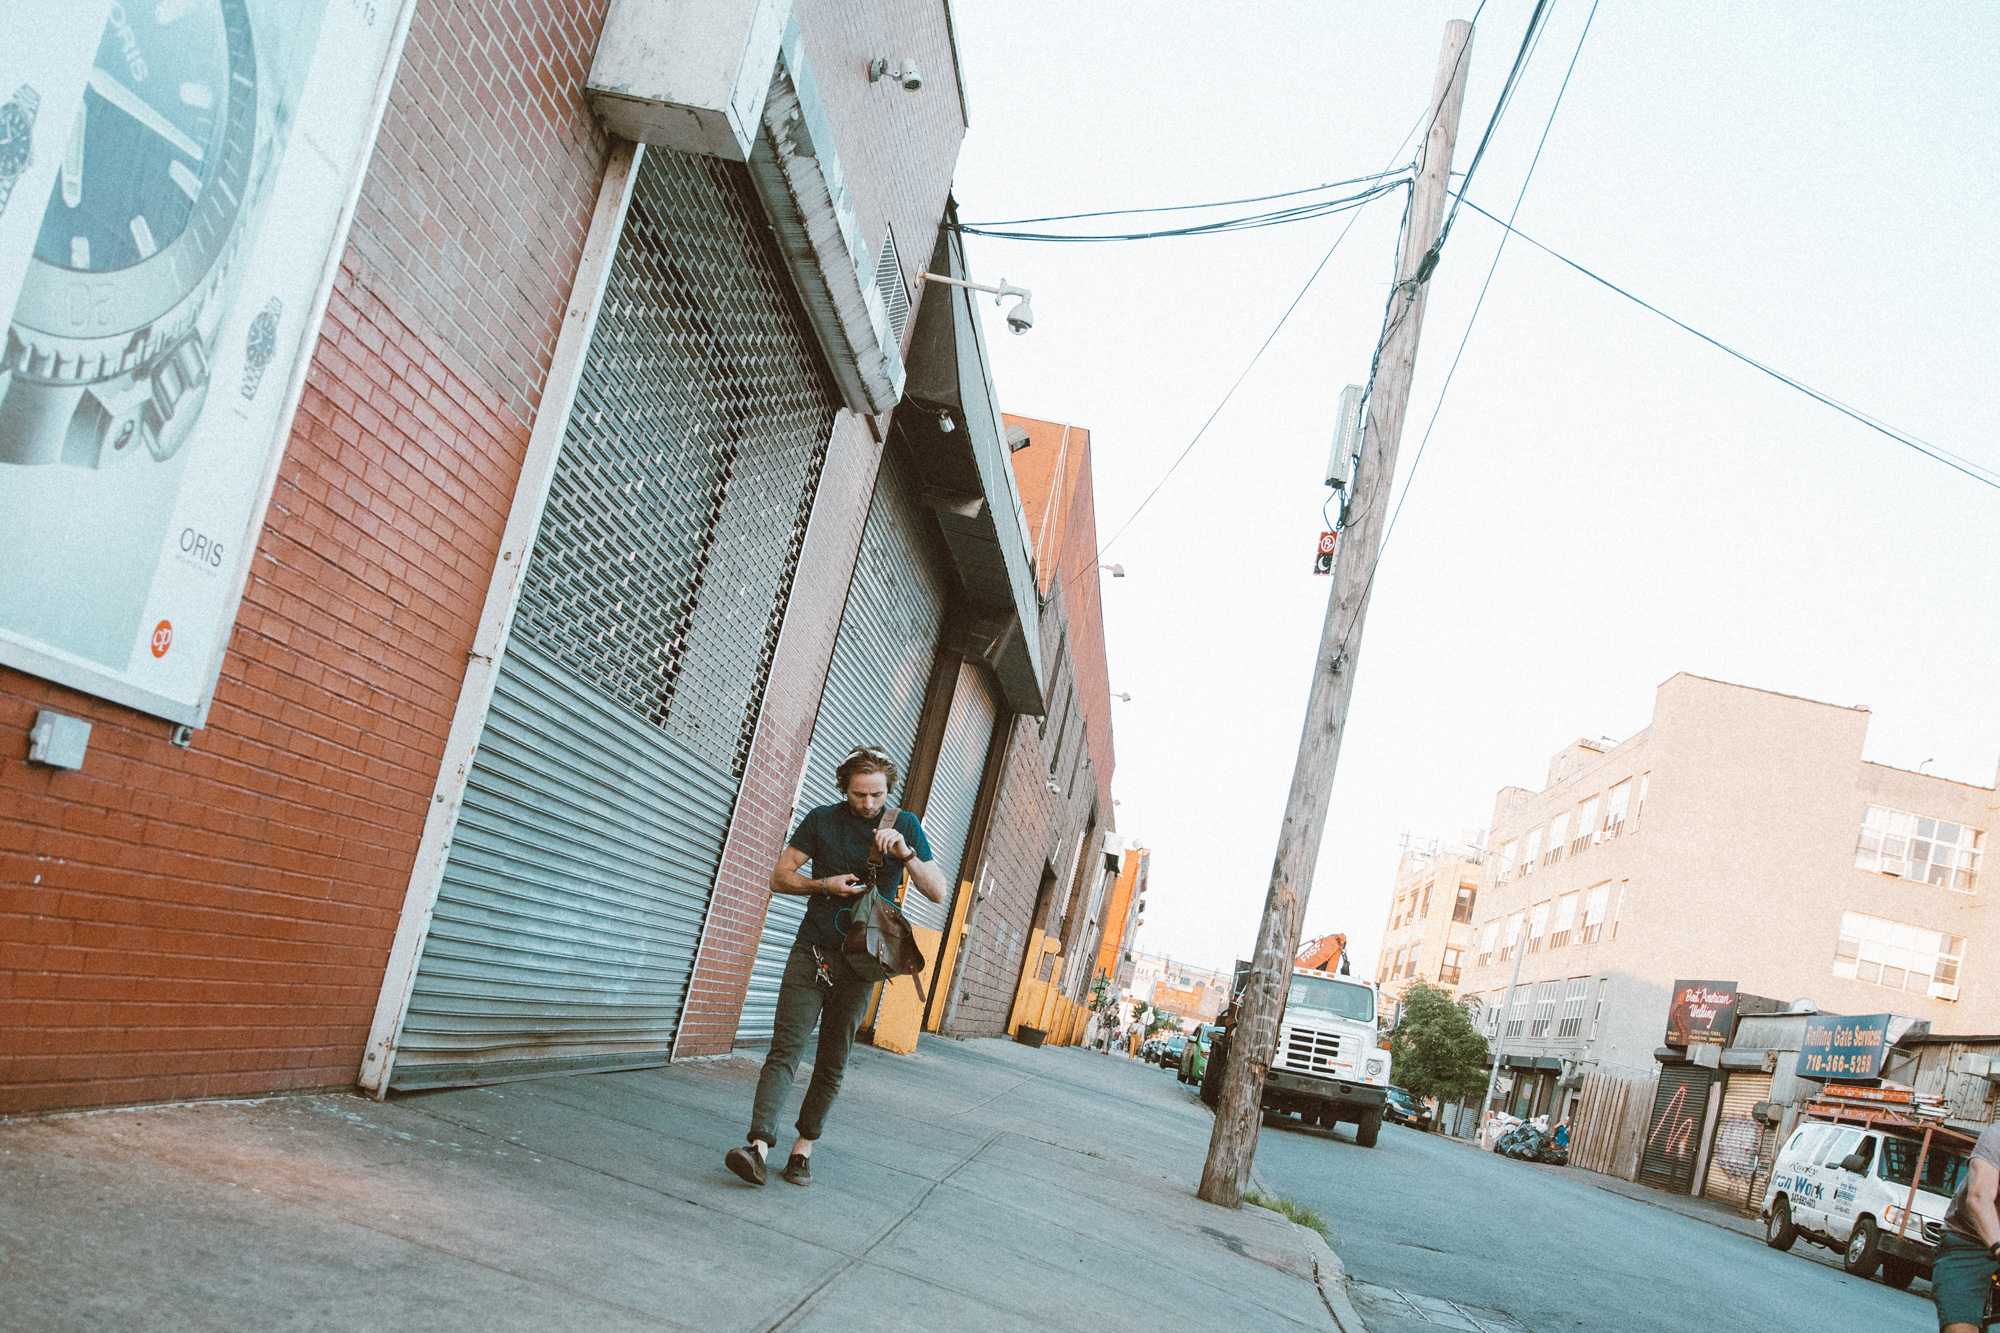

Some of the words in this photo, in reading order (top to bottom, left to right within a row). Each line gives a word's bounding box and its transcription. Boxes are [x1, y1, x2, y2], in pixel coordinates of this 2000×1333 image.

[109, 1, 149, 82] ORIS
[180, 527, 224, 567] ORIS
[1689, 1004, 1717, 1029] Welding
[1805, 1025, 1833, 1052] Rolling
[1834, 1025, 1853, 1047] Gate
[1854, 1025, 1882, 1047] Services
[1789, 1162, 1819, 1177] Rocky
[1771, 1170, 1793, 1190] Iron
[1795, 1175, 1825, 1200] Work
